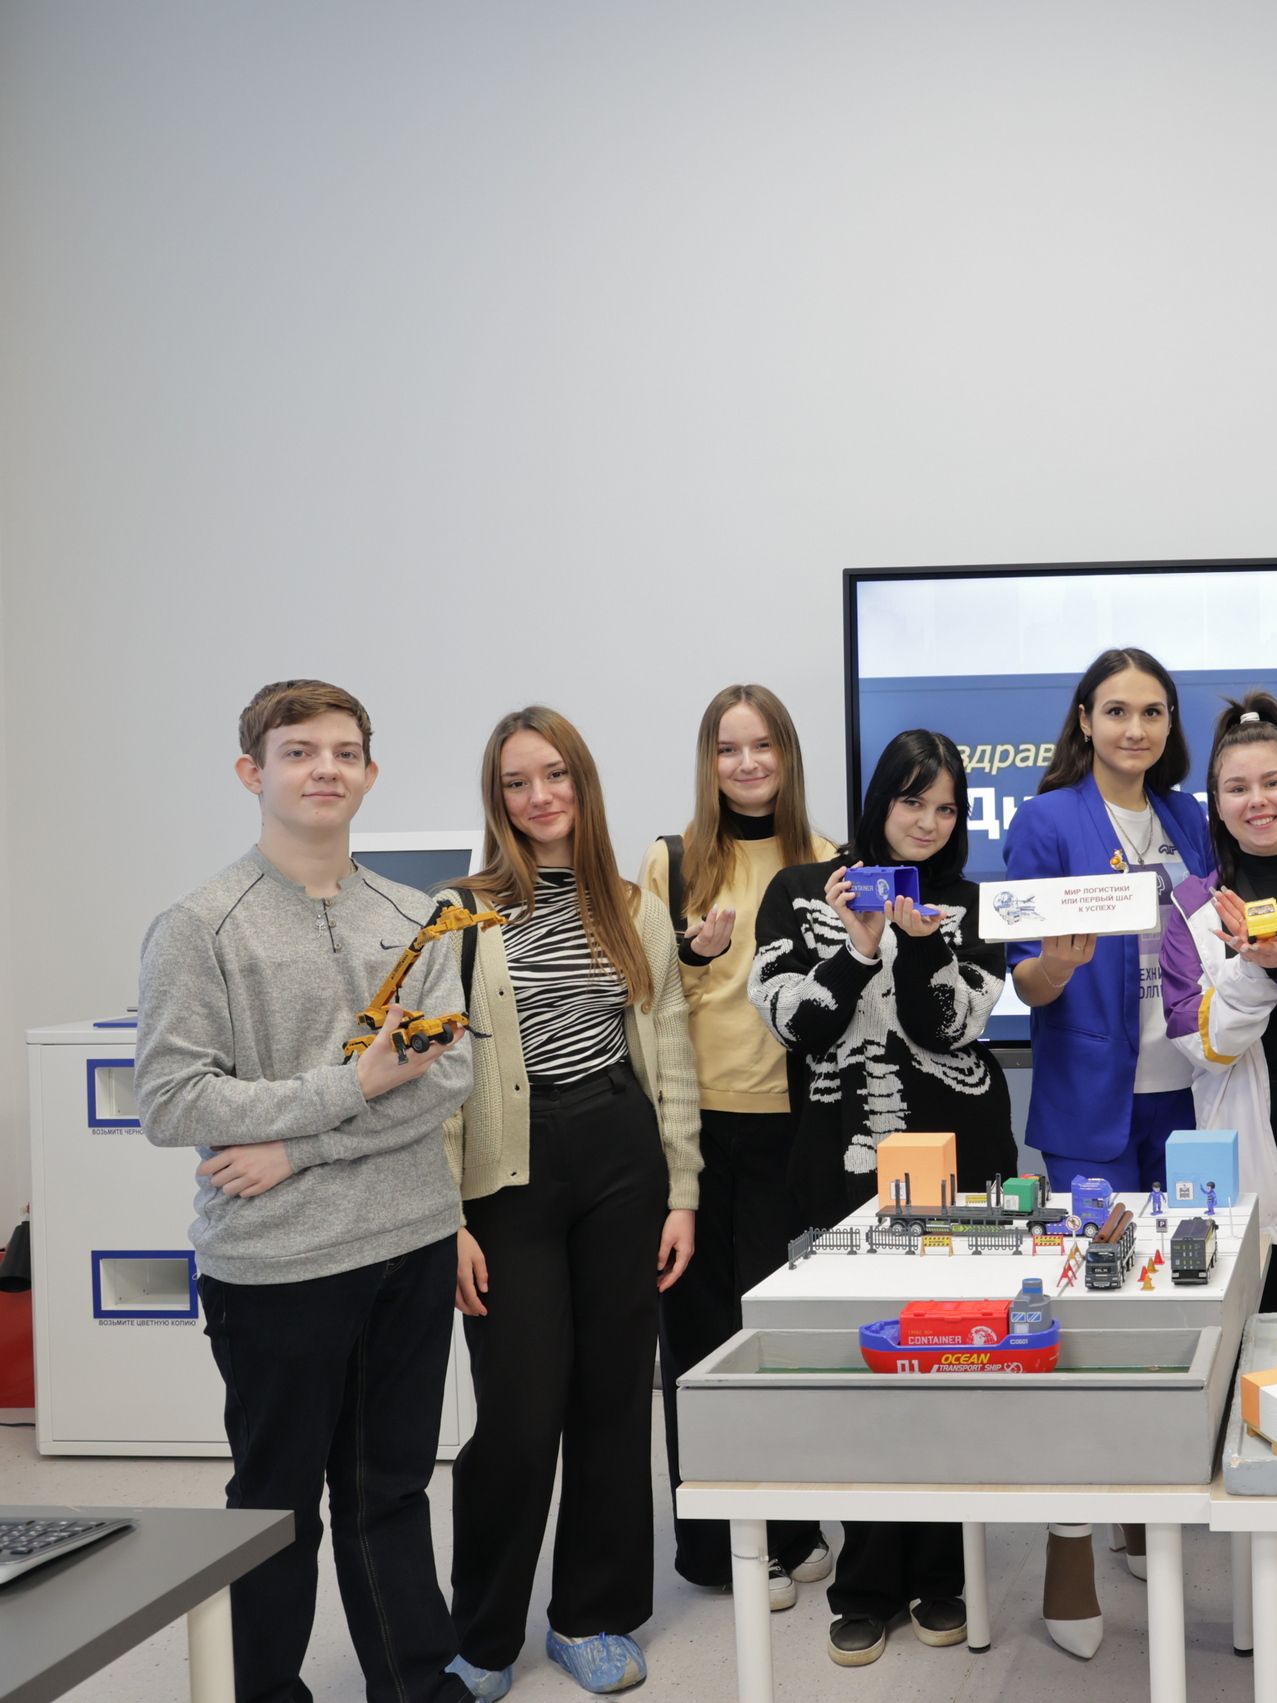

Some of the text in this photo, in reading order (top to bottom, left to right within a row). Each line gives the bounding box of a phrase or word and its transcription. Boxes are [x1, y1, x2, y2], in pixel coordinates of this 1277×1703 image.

[1083, 885, 1130, 895] ЛОГИСТИКИ
[1079, 895, 1114, 904] ПЕРВЫЙ
[1115, 894, 1133, 902] ШАГ
[1085, 904, 1117, 912] УСПЕХУ
[92, 1128, 123, 1136] ВОЗЬМИТЕ
[908, 1336, 962, 1345] CONTAINER
[941, 1353, 990, 1365] OCEAN
[938, 1364, 1002, 1373] TRANSPORT SHIP
